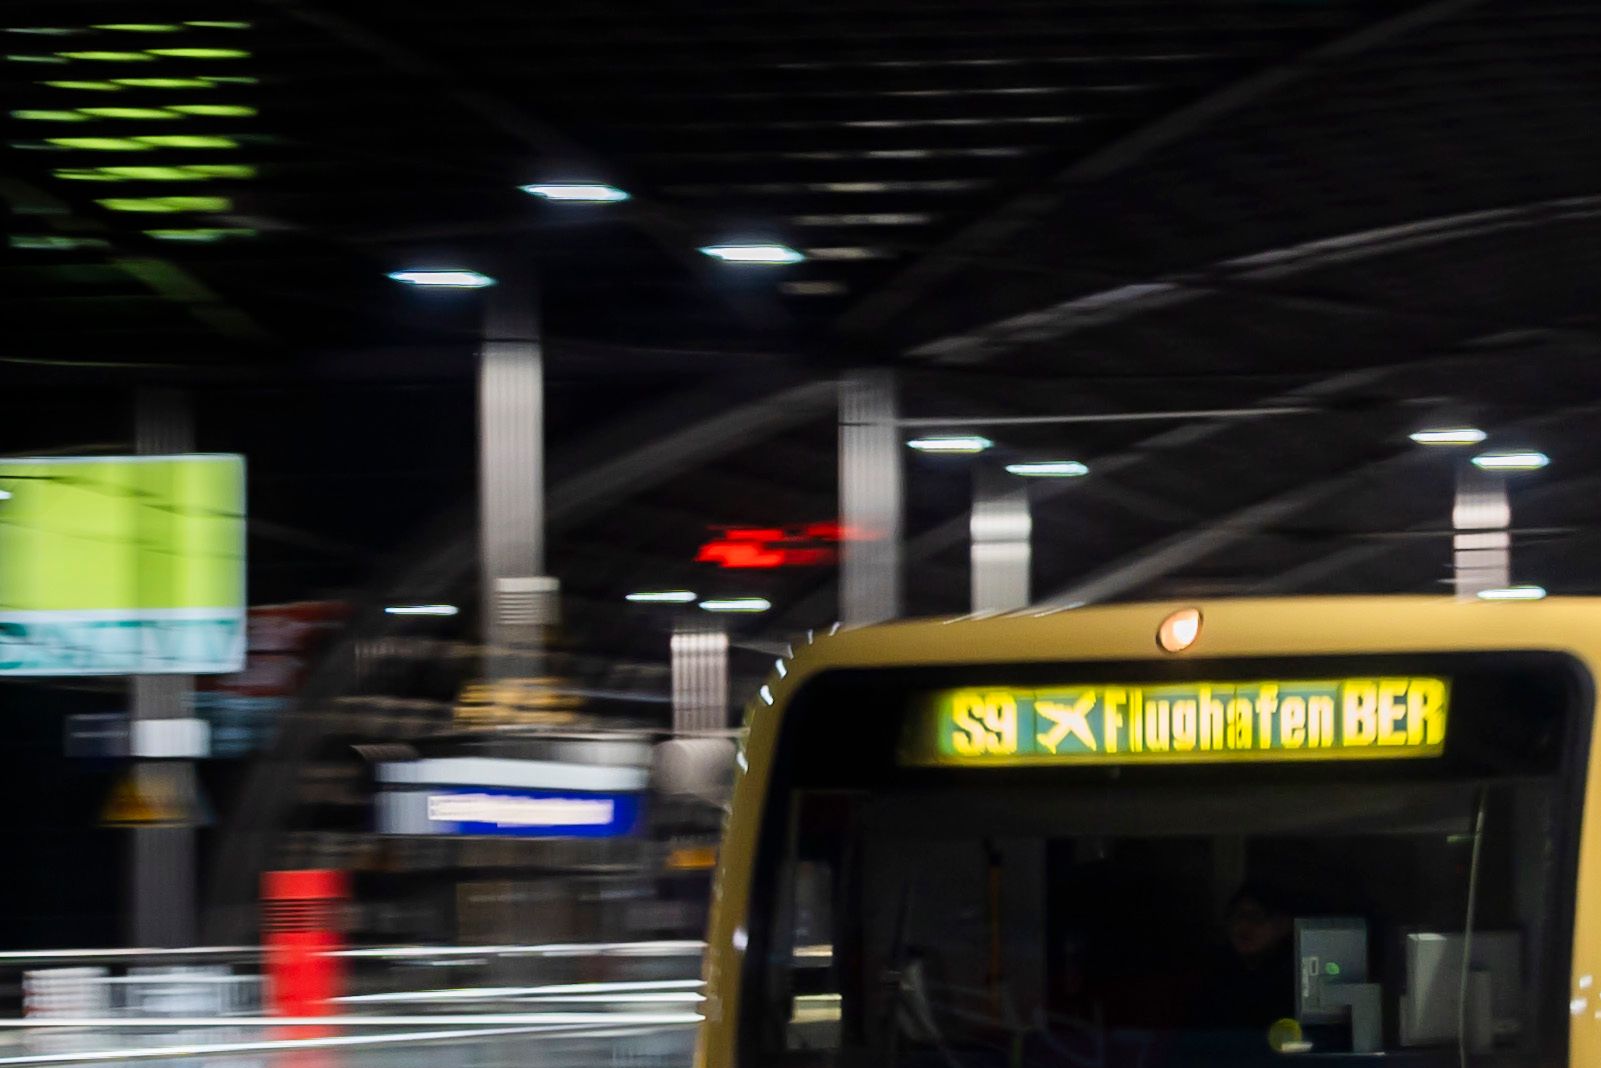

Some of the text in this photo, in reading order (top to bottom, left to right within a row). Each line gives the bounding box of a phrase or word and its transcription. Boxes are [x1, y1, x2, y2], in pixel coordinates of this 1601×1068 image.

[951, 678, 1447, 756] S9 Flughafen BER
